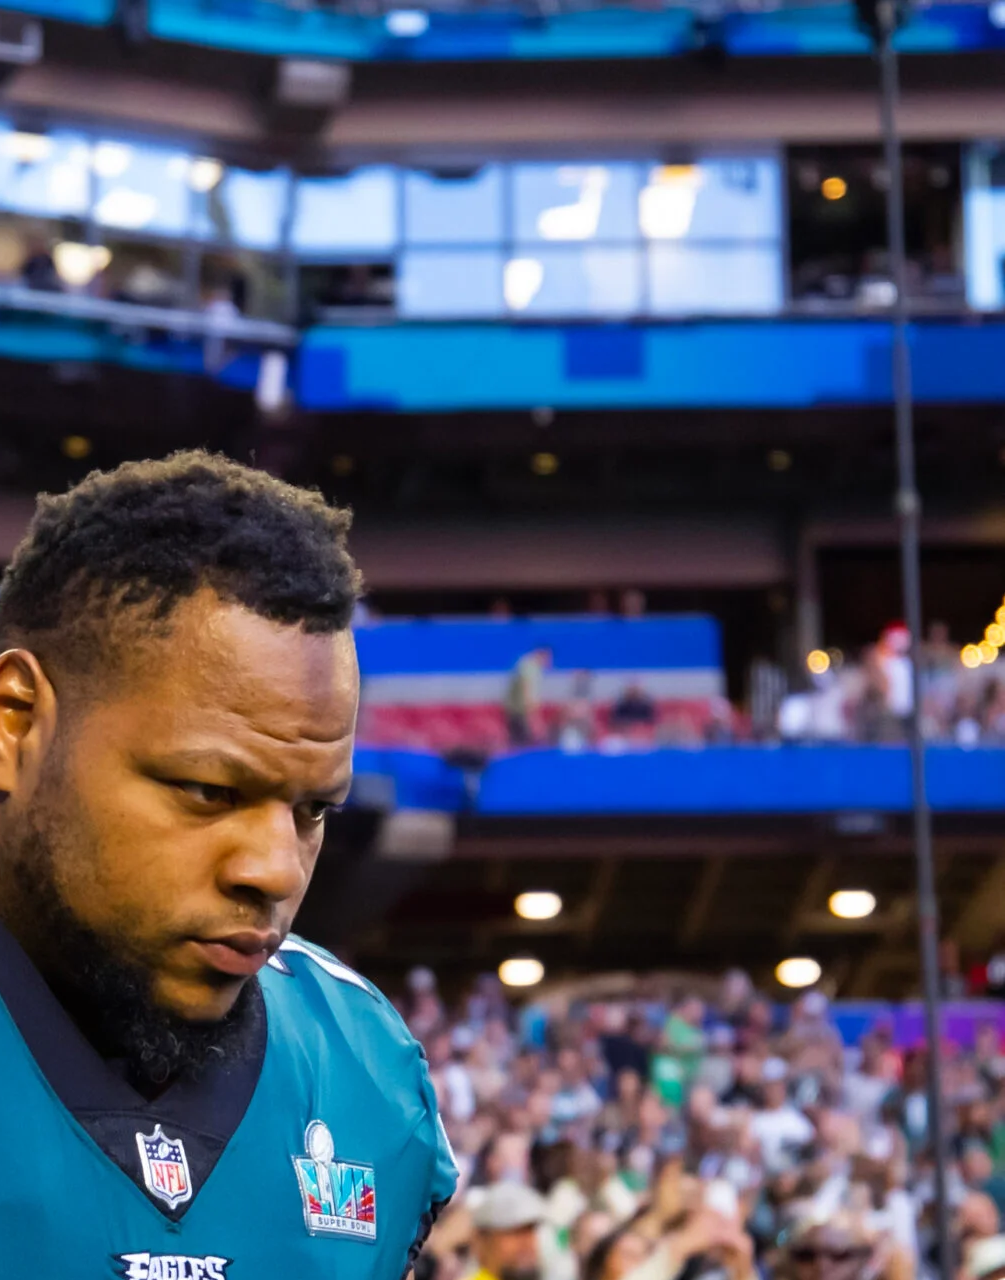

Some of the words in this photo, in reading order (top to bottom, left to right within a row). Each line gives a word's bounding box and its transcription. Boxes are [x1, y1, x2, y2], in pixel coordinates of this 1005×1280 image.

[152, 1162, 185, 1193] NFL
[317, 1216, 348, 1228] SUPER
[350, 1221, 371, 1233] BOWL
